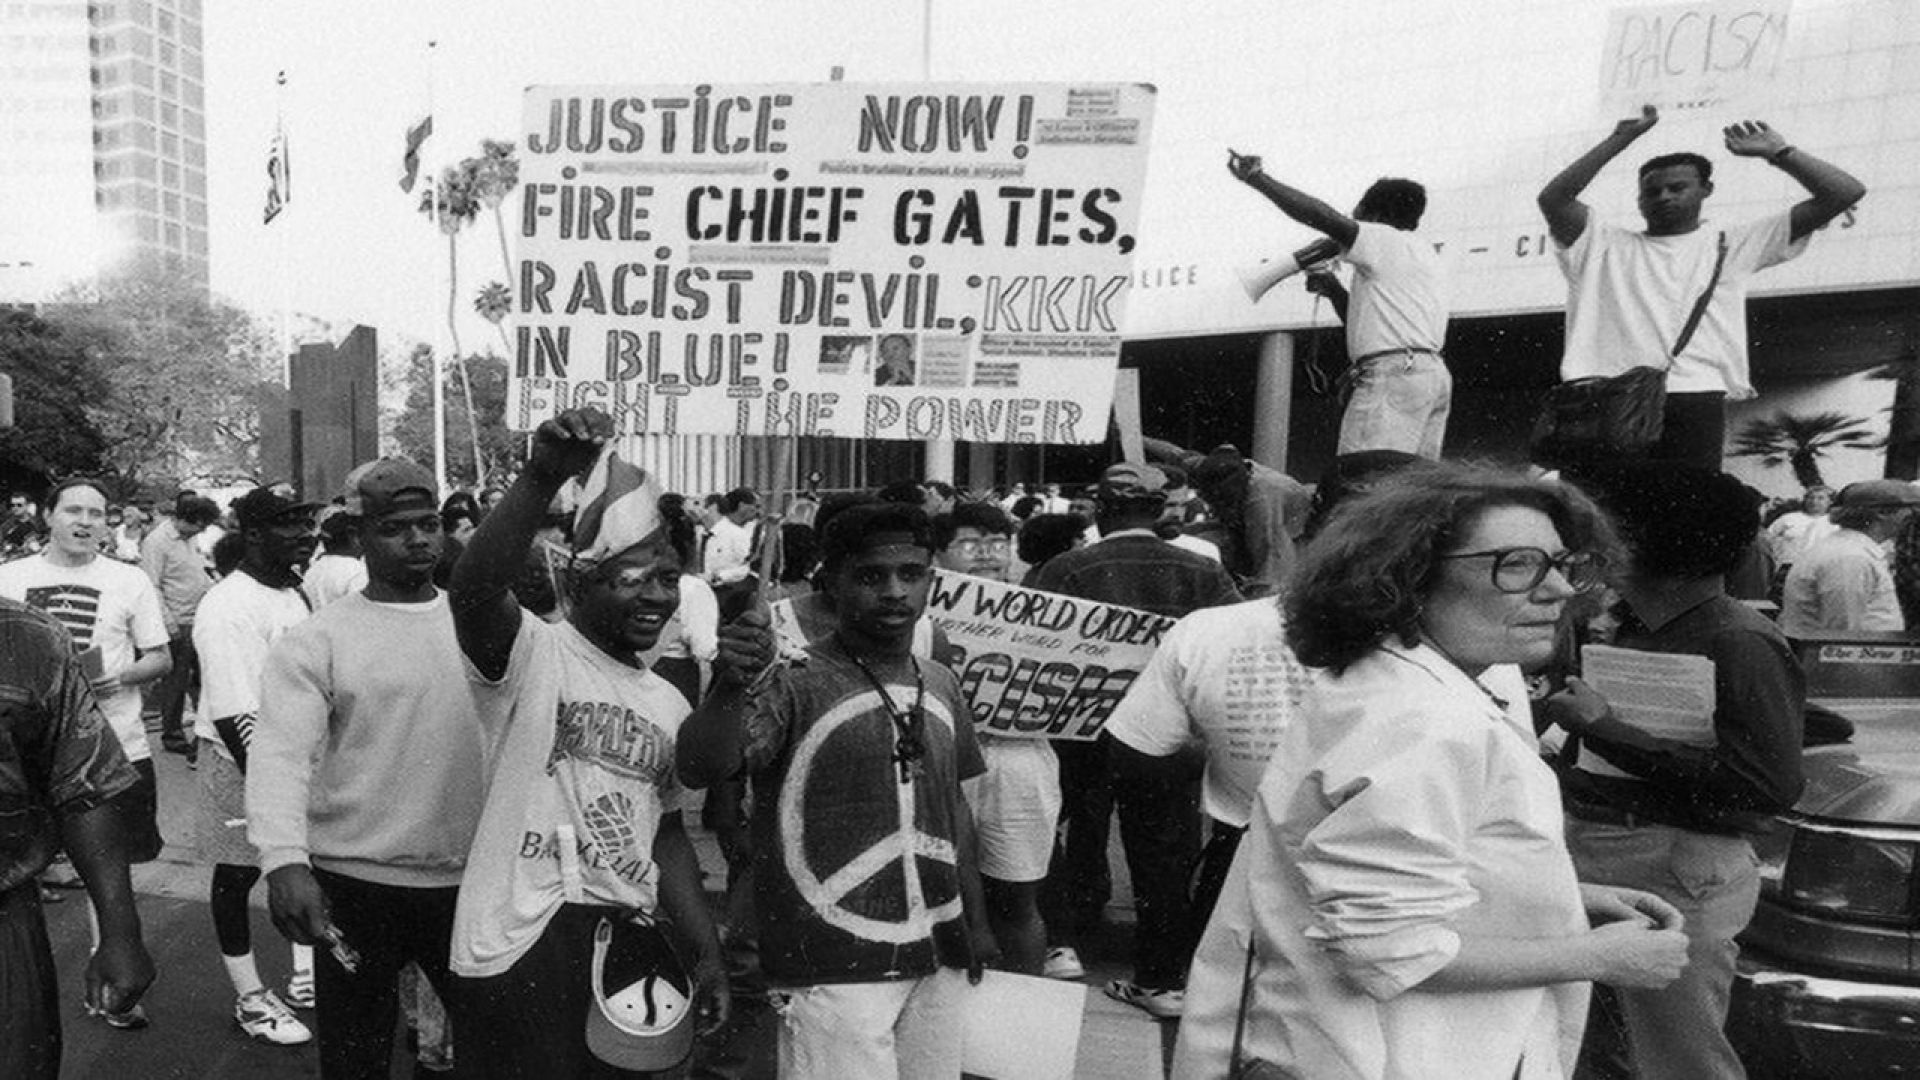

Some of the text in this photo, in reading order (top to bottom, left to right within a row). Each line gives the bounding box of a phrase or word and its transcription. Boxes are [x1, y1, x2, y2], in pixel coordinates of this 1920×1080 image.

[1609, 10, 1788, 88] RACISM
[527, 84, 1034, 159] JUSTICE NOW!
[522, 166, 1136, 255] FIRE CHIEF GATES,
[520, 246, 753, 324] RACIST
[983, 275, 1127, 333] KKK
[1129, 264, 1198, 288] LICE
[516, 326, 790, 391] IN BLUE!
[727, 386, 839, 438] THE
[864, 393, 1082, 444] POWER
[974, 584, 1077, 631] WORLD
[1069, 643, 1110, 658] FOR
[949, 644, 1140, 736] CISM
